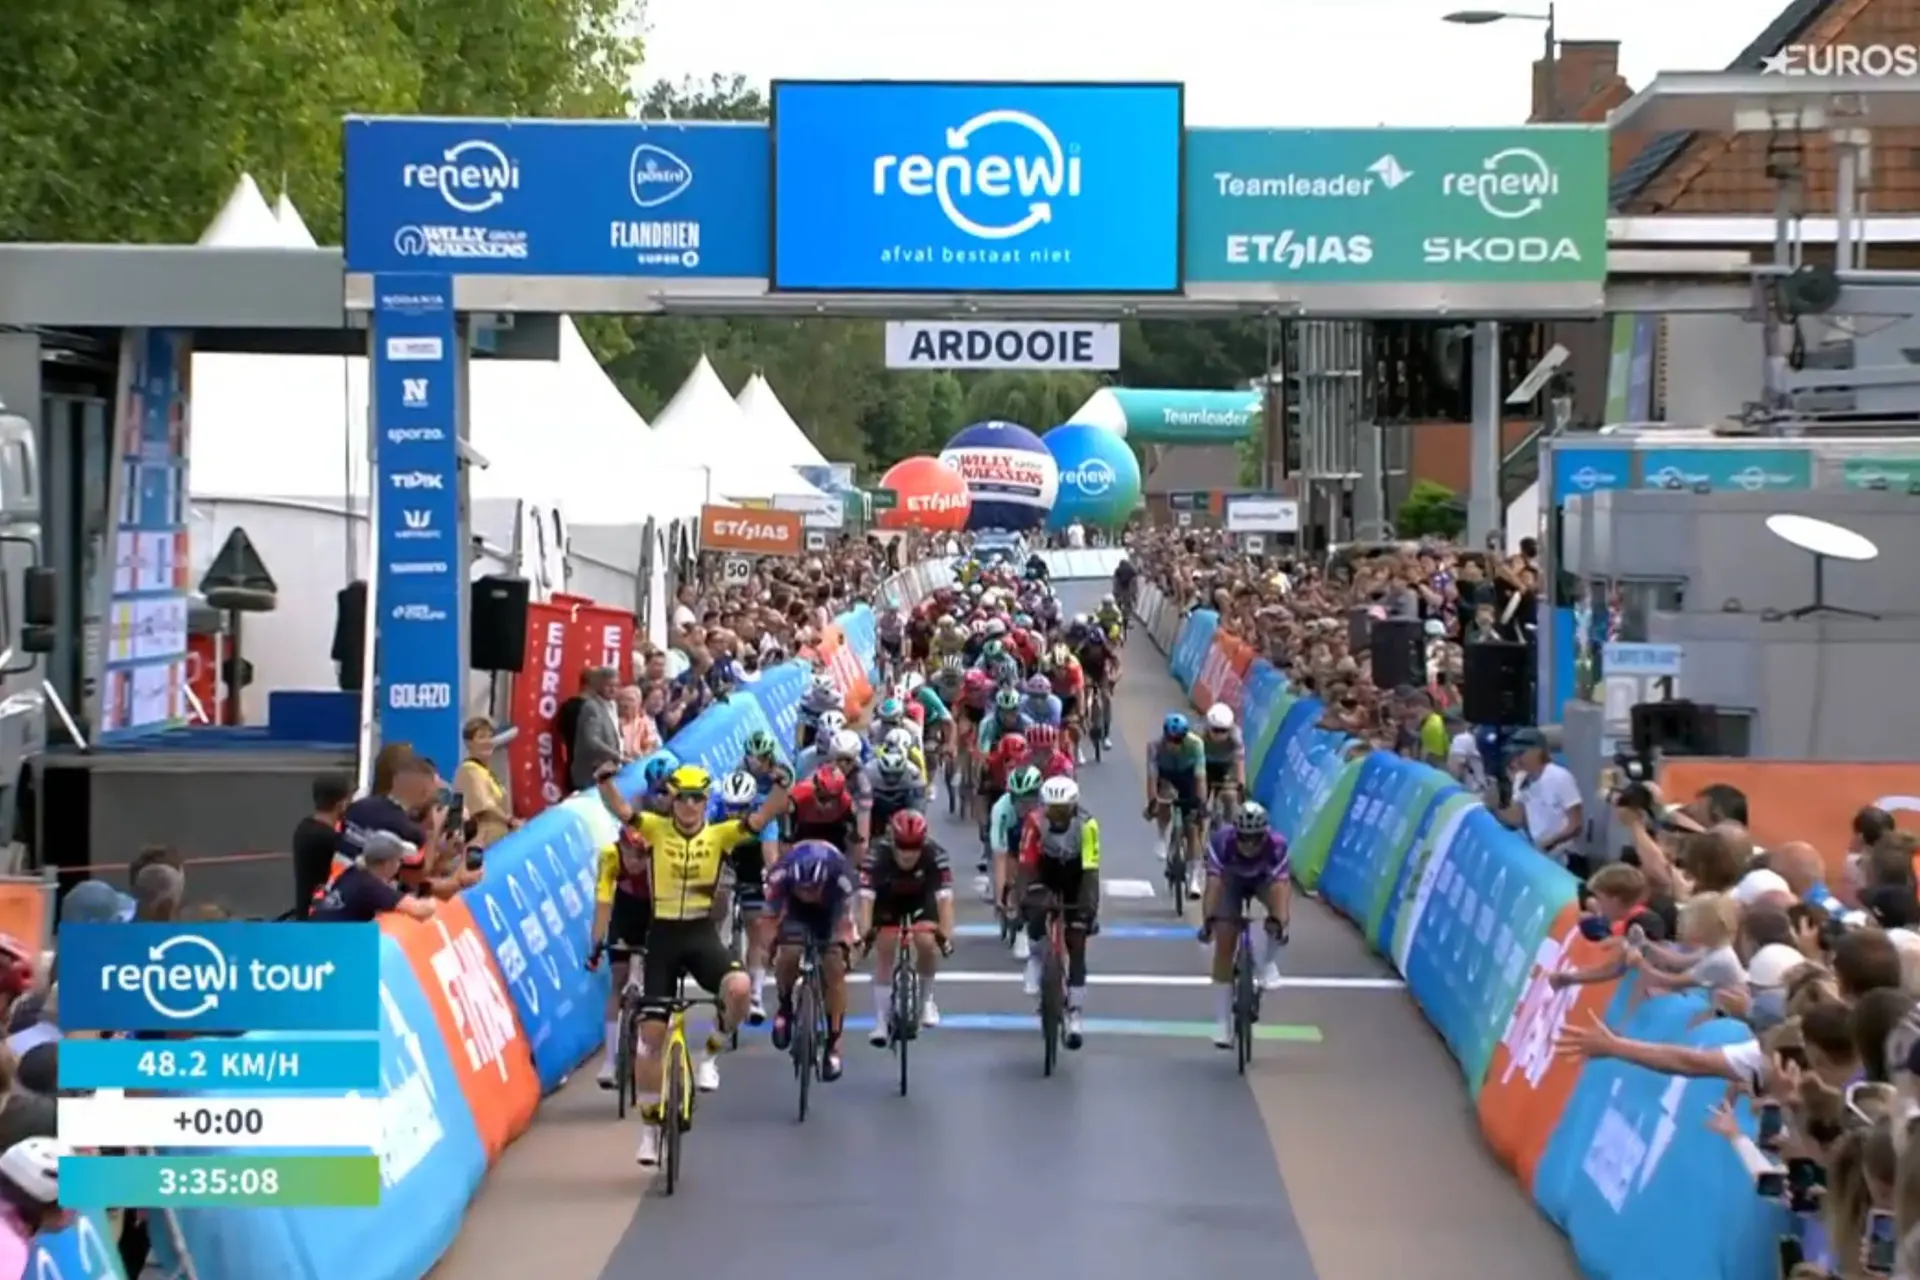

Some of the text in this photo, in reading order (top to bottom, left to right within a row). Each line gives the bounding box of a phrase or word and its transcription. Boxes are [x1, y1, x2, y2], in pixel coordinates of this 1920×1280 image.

[1214, 172, 1374, 197] Teamleader
[611, 221, 700, 248] FLANDRIEN
[880, 246, 1071, 263] afval bestaat niet
[909, 329, 1094, 362] ARDOOIE
[1162, 407, 1248, 426] Teamleader
[961, 454, 1013, 467] WILLY
[961, 467, 1043, 485] NAESSENS
[728, 562, 748, 578] 50
[389, 683, 450, 708] GOLAZO
